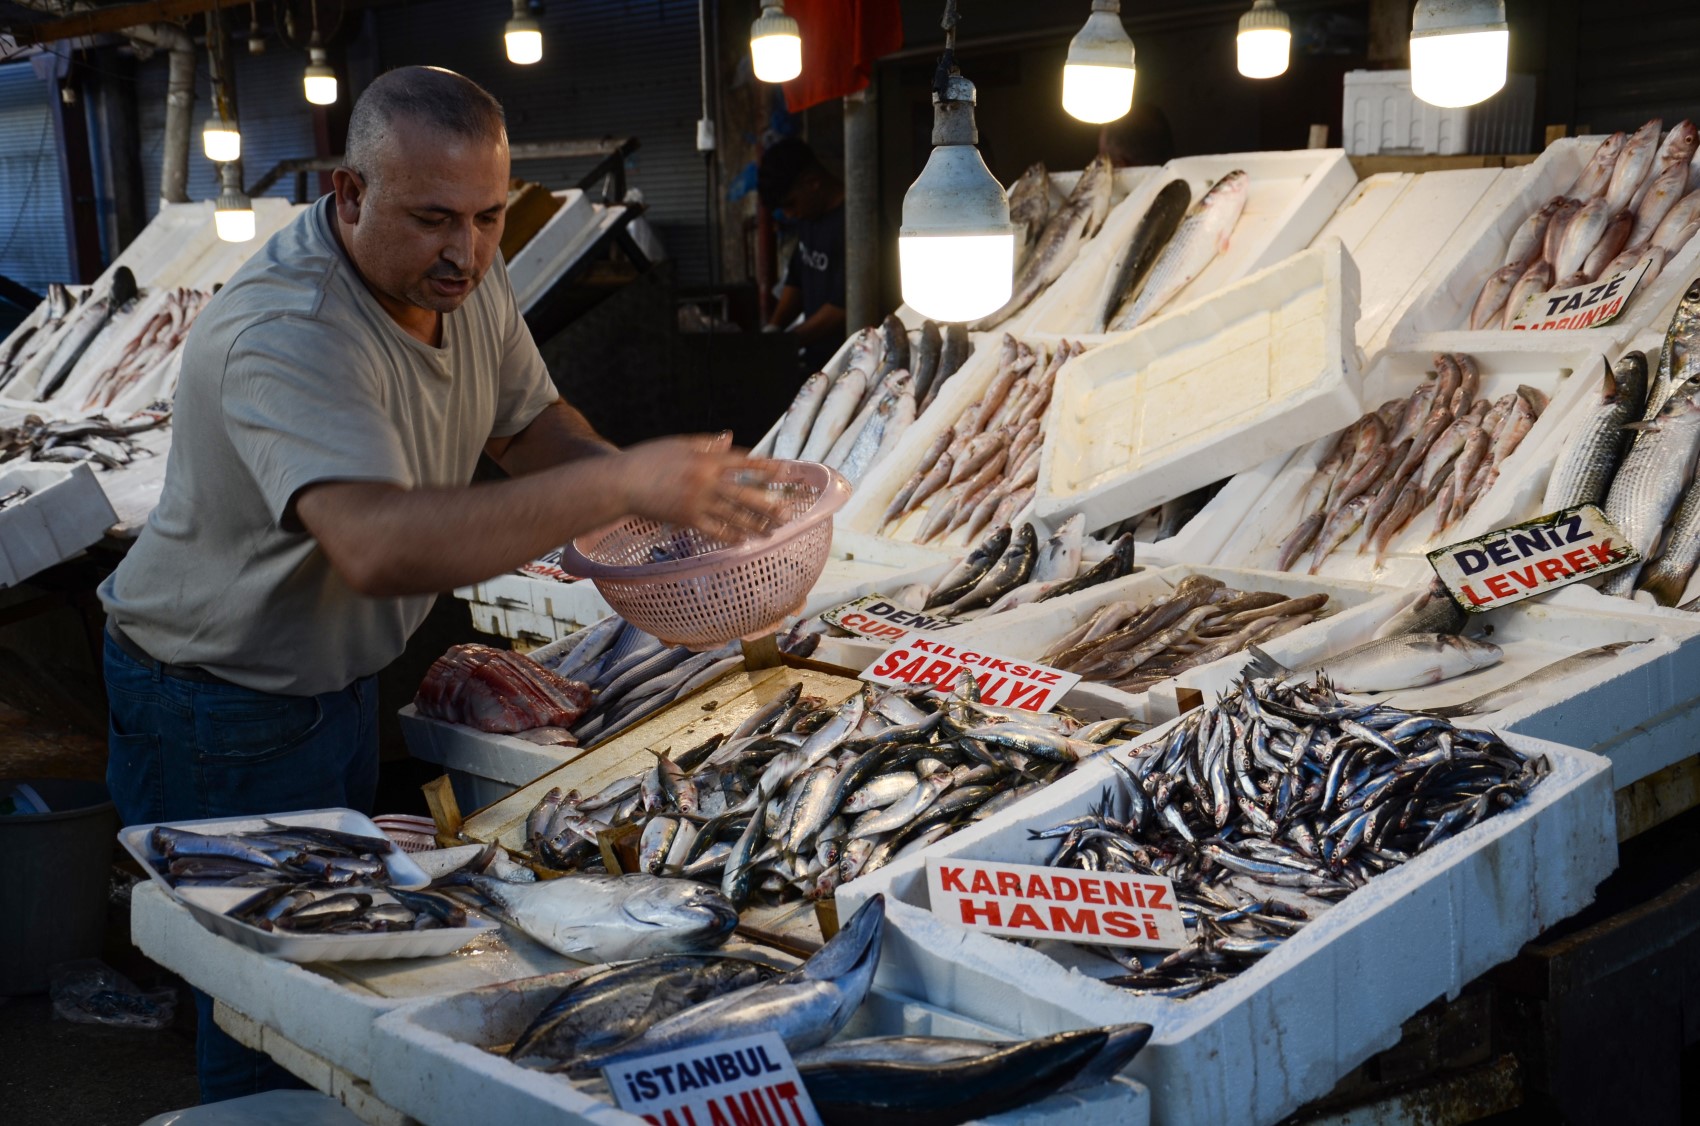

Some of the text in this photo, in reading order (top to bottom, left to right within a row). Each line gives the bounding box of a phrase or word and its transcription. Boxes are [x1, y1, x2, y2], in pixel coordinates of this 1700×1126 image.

[1546, 276, 1627, 316] TAZE
[1460, 538, 1629, 607] LEVREK
[873, 650, 1051, 712] SARDALYA
[910, 639, 1062, 685] KILÇIKSIZ
[640, 1081, 808, 1126] AMUT
